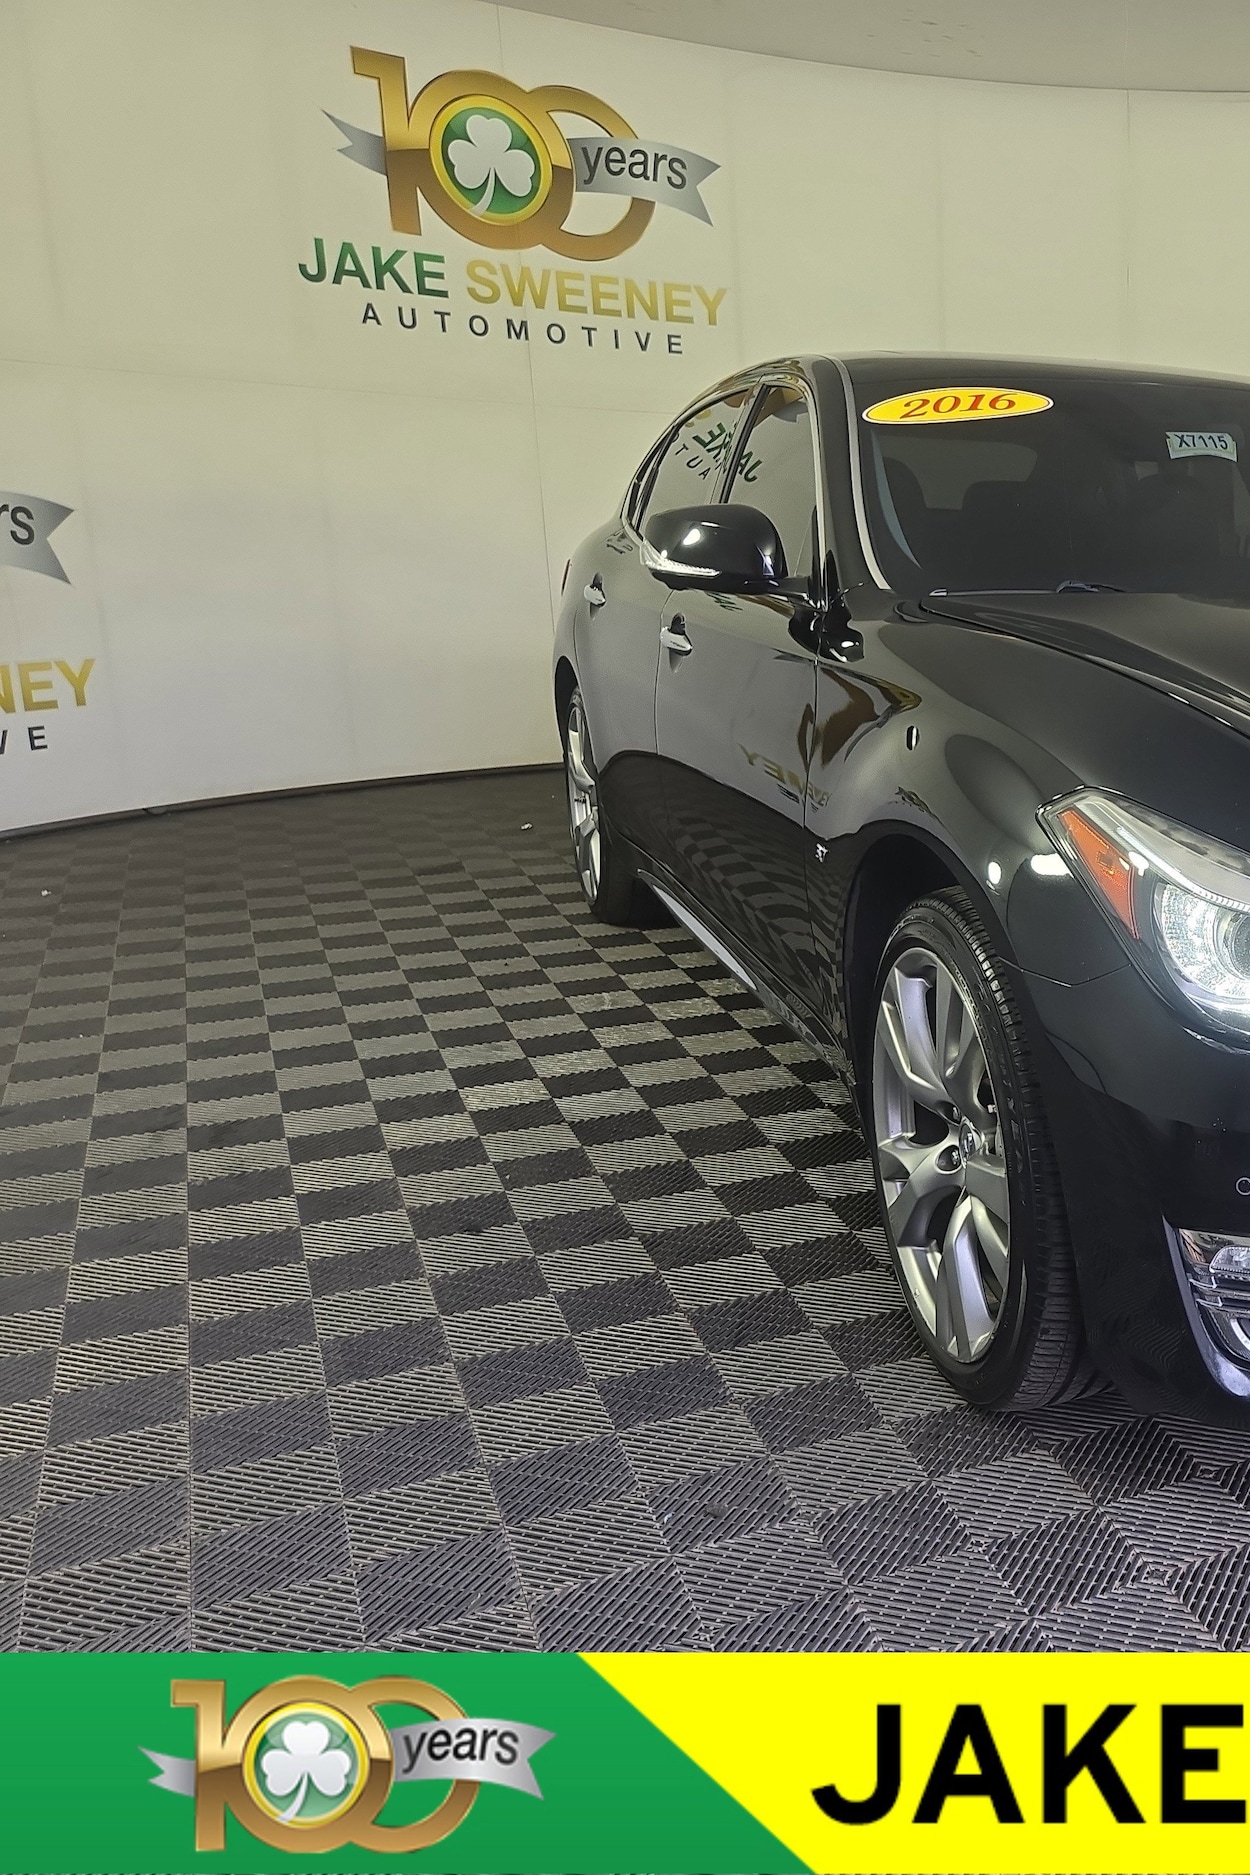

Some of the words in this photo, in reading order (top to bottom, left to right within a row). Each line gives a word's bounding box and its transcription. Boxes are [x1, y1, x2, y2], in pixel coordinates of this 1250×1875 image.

[580, 145, 688, 190] years
[298, 237, 449, 299] JAKE
[466, 259, 728, 327] SWEENEY
[361, 302, 684, 355] AUTOMOTIVE
[899, 392, 1017, 420] 2016
[1174, 432, 1229, 451] X7115
